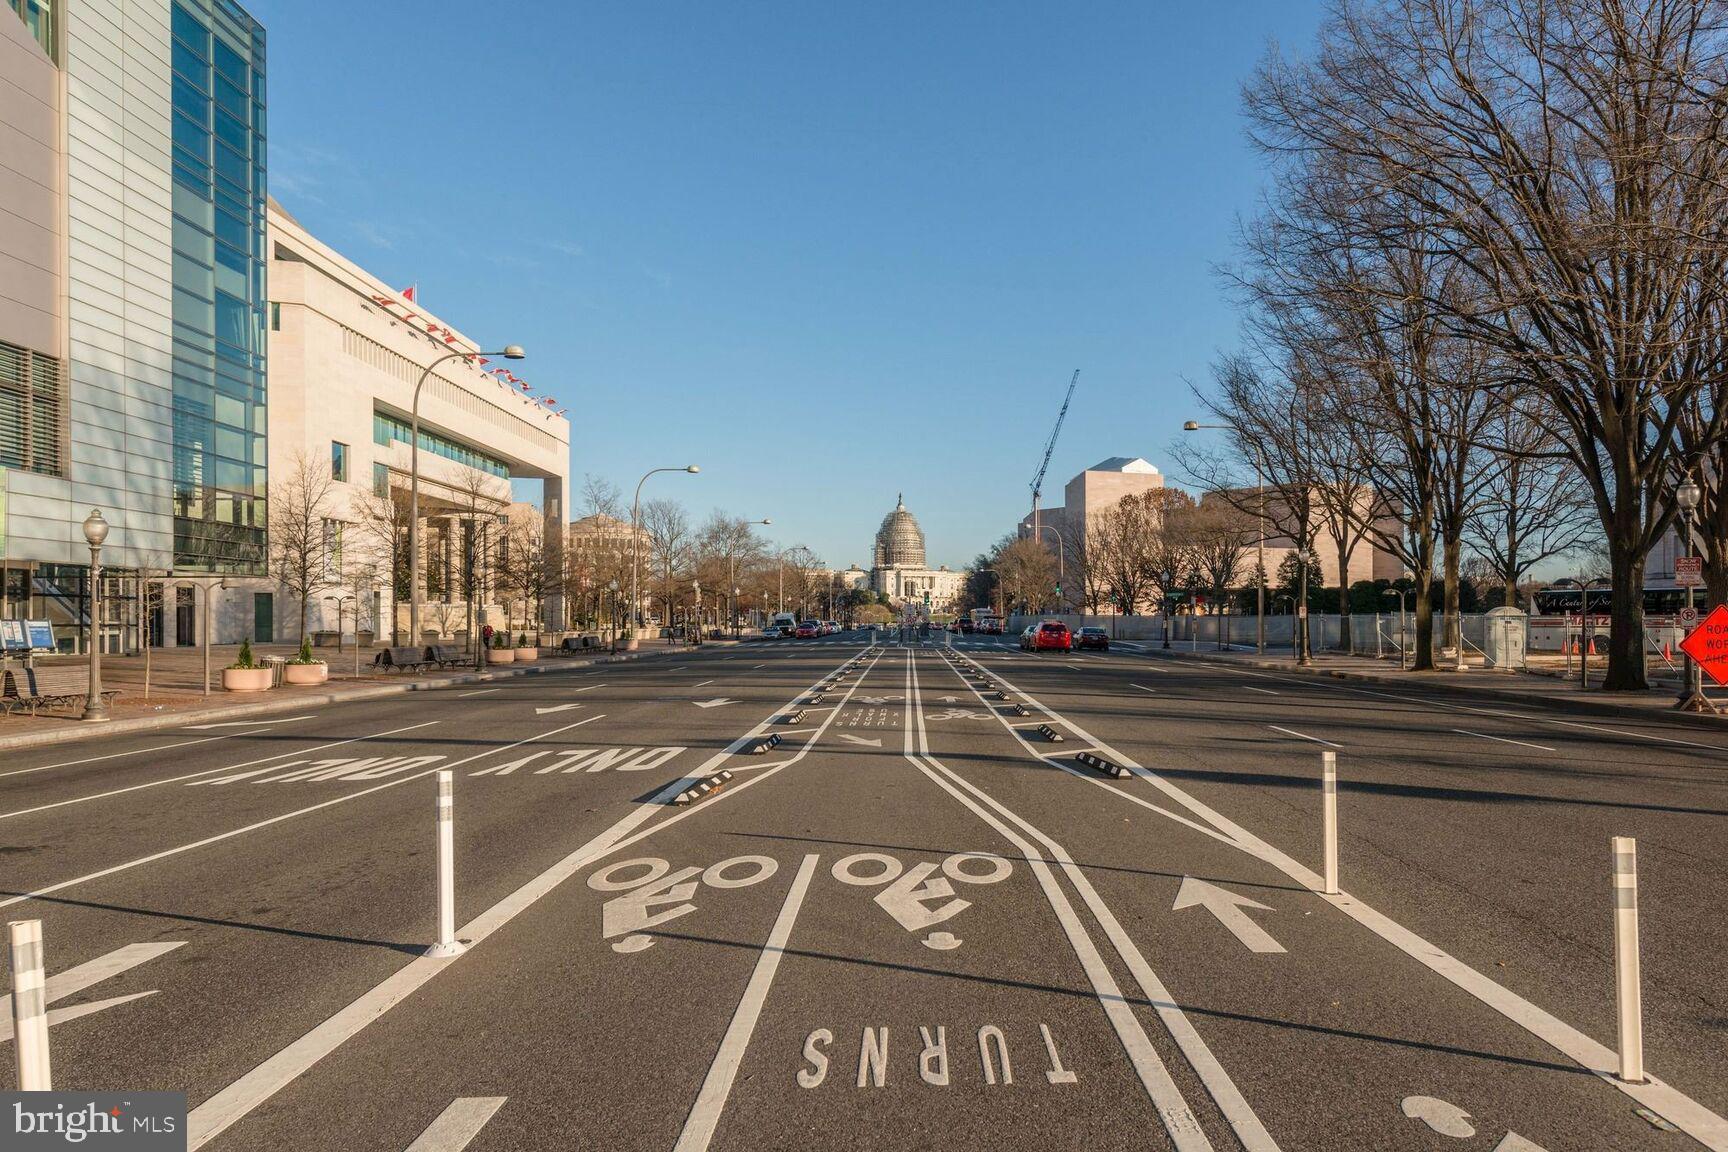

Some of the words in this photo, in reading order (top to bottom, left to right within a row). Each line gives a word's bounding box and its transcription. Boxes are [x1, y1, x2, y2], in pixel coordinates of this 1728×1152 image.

[1600, 597, 1611, 606] Ser
[1707, 625, 1728, 635] ROA
[1704, 655, 1728, 664] AHE
[184, 755, 447, 785] ONLY
[468, 747, 687, 776] ONLY
[796, 1023, 1078, 1088] TURNS
